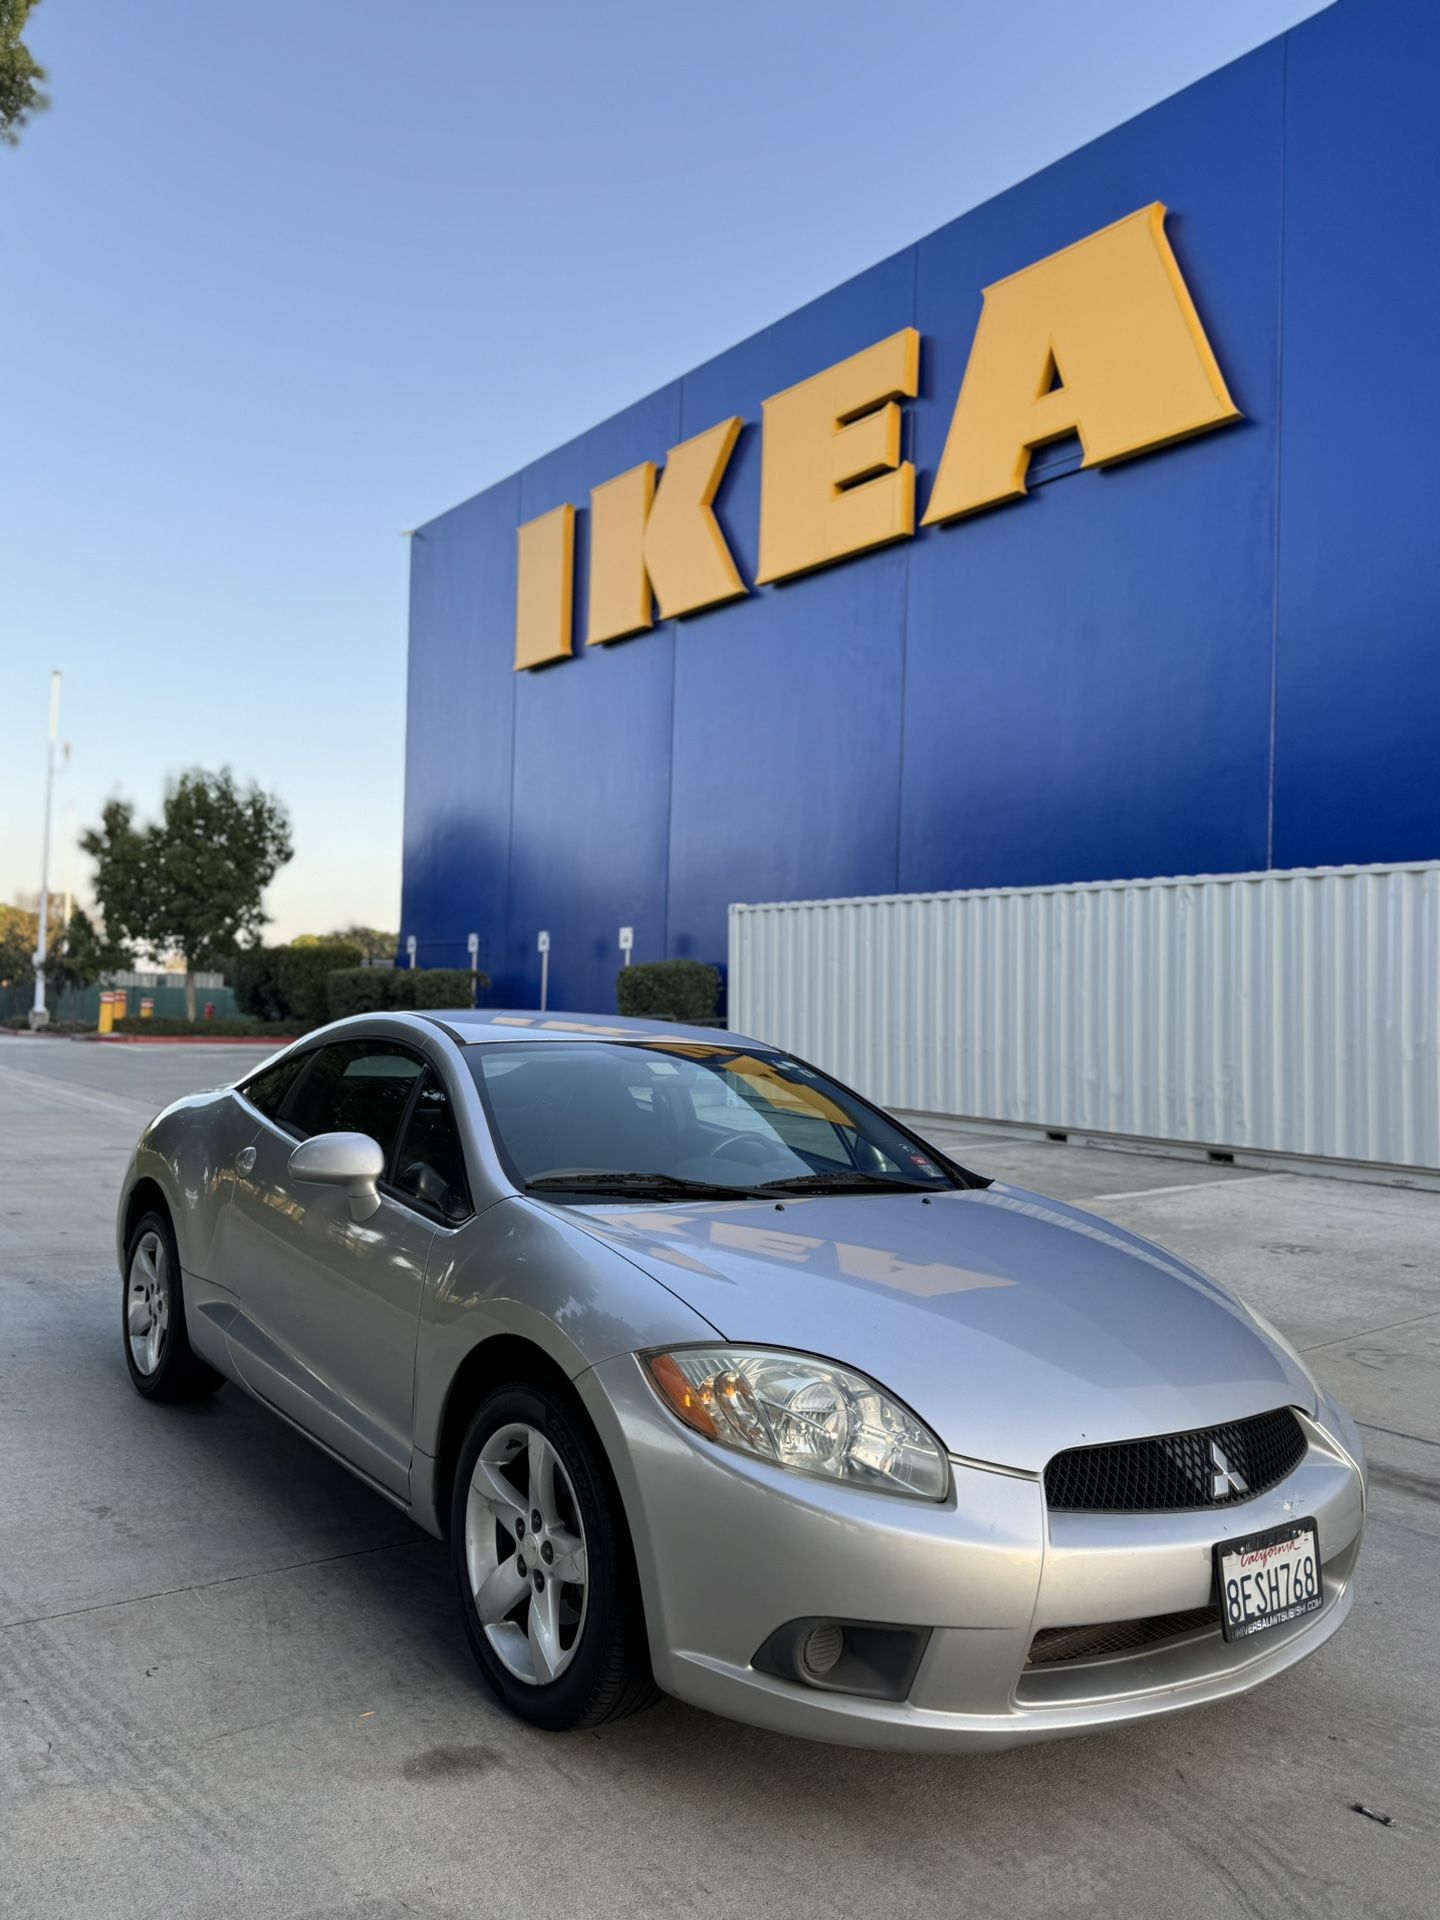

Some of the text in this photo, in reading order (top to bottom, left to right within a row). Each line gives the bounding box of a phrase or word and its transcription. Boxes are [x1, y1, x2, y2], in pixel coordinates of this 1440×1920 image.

[513, 200, 1244, 673] IKEA
[1240, 1540, 1302, 1568] California
[1226, 1555, 1316, 1623] 8ESH768
